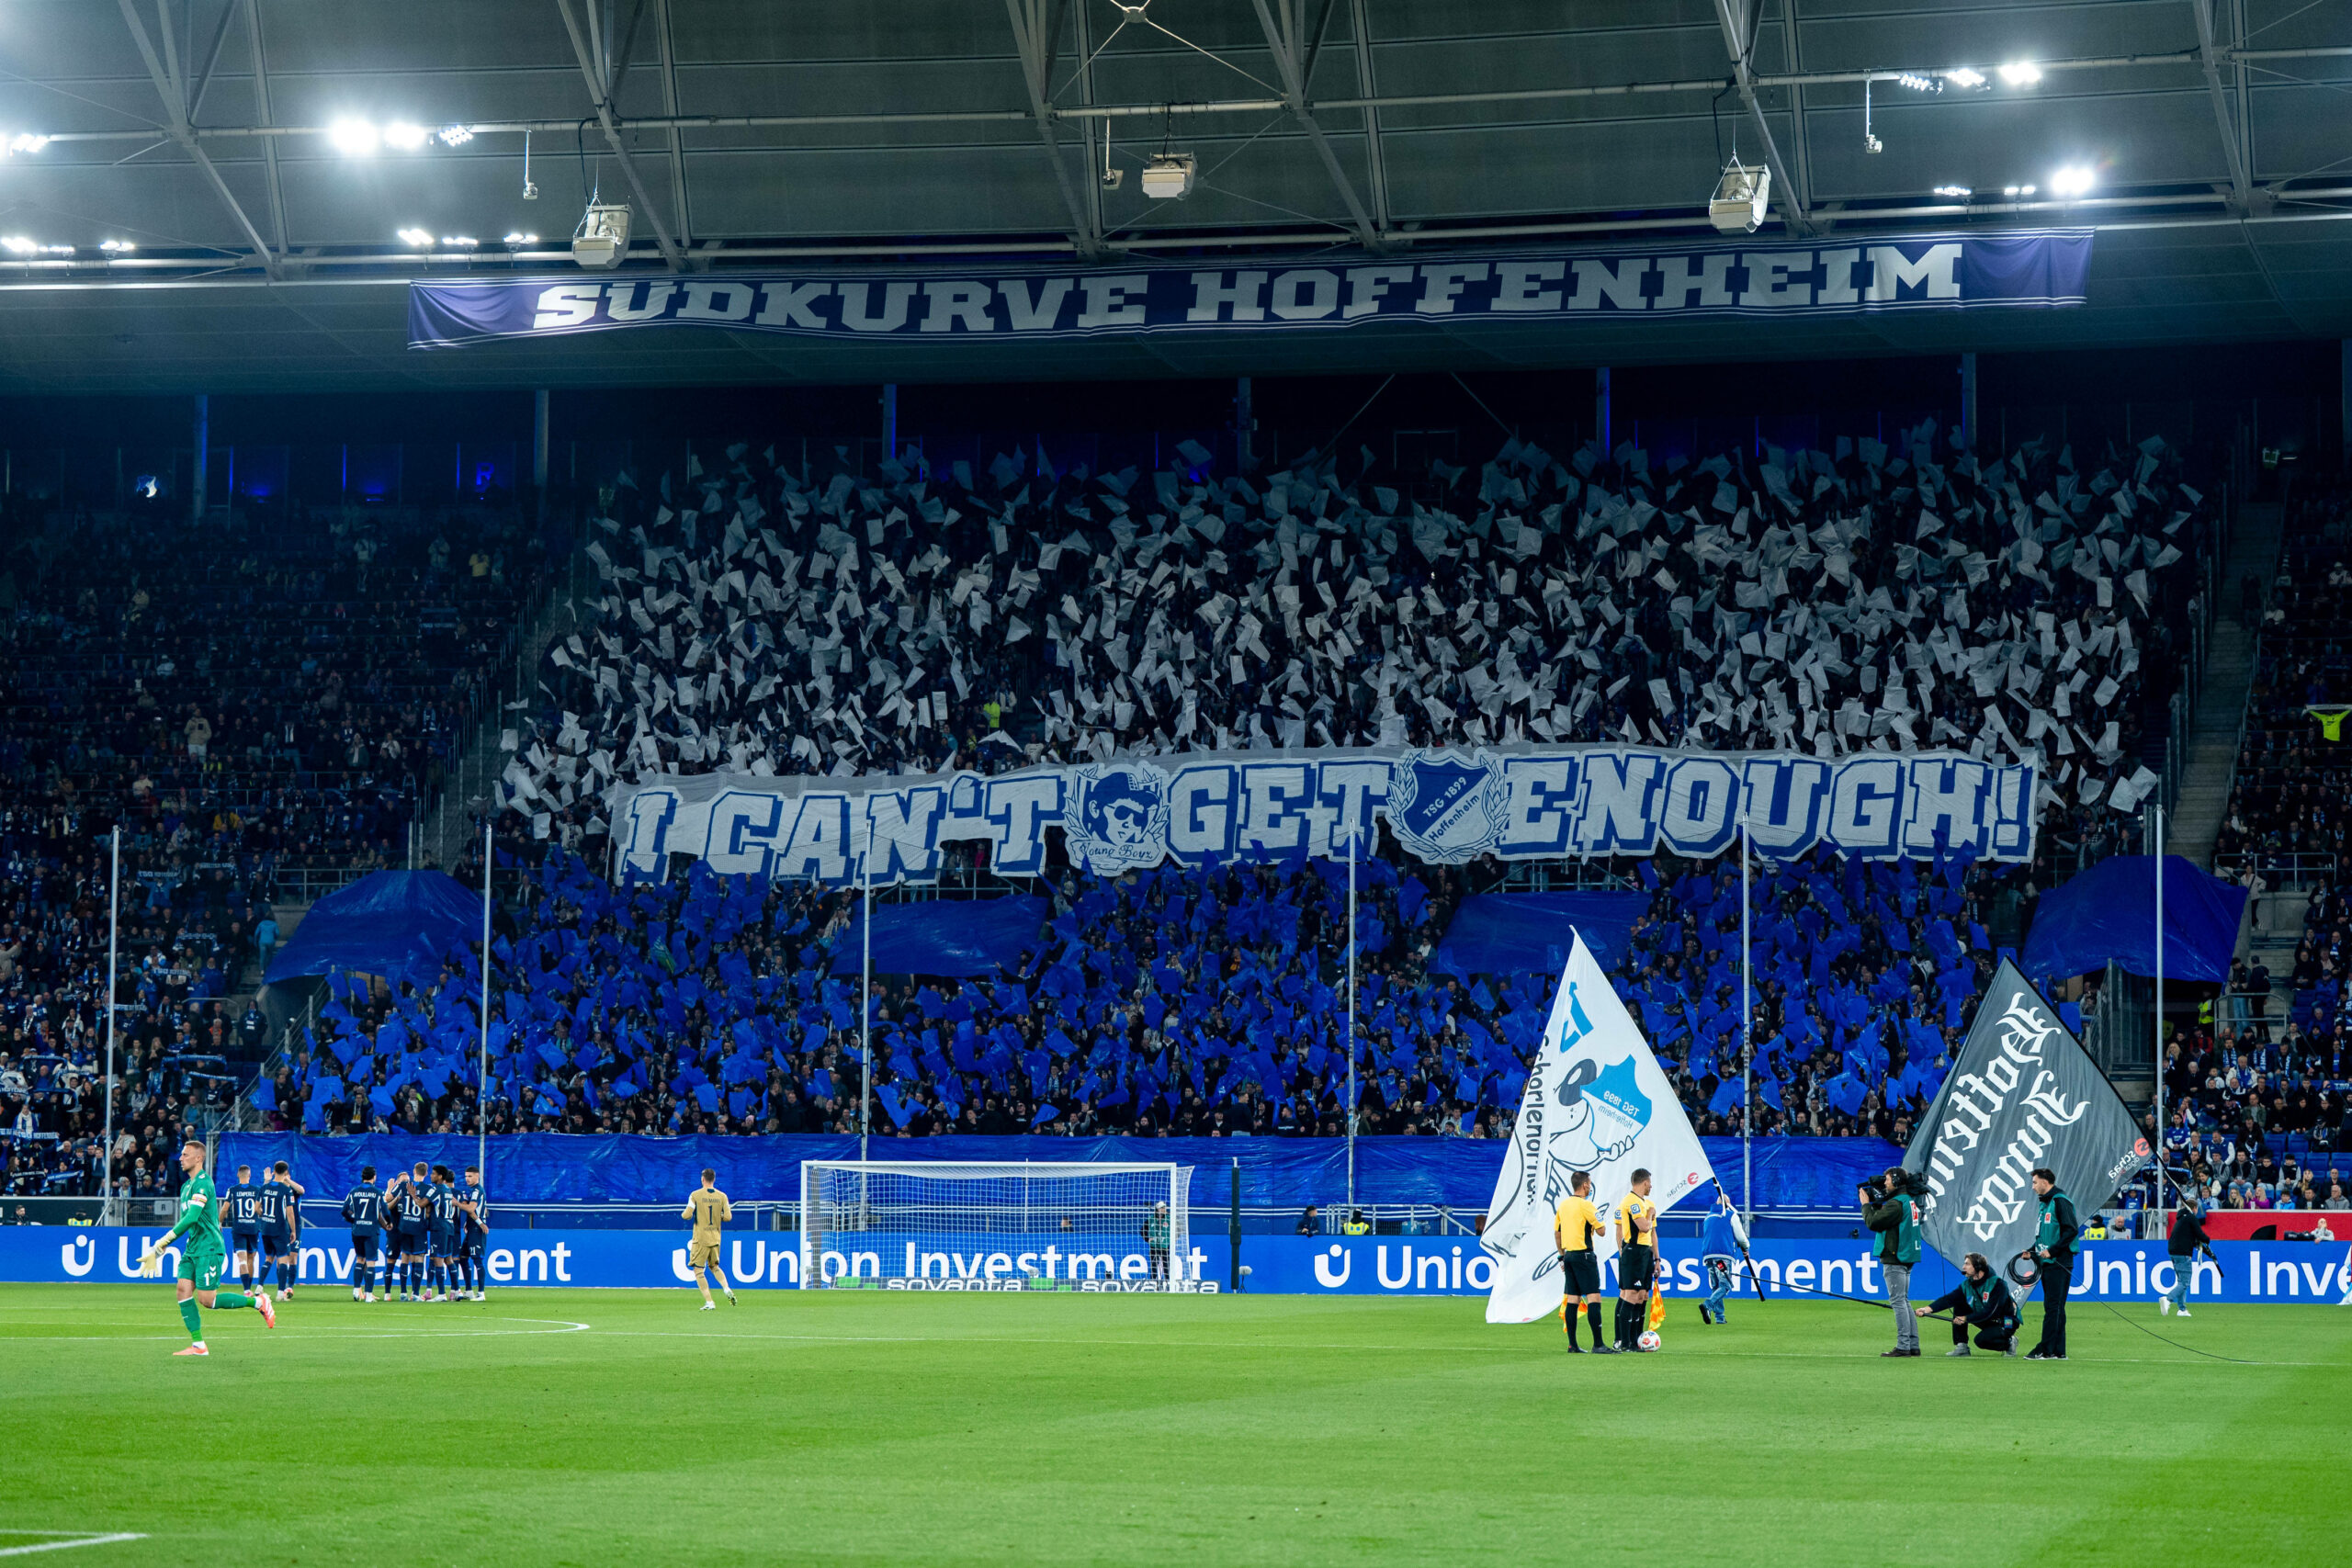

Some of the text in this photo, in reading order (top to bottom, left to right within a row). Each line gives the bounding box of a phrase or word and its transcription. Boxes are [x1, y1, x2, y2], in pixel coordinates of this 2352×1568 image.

[533, 243, 1964, 332] SÜDKURVE HOFFENHEIM
[1423, 776, 1467, 817] TSG 1899
[622, 791, 678, 882] I
[1165, 759, 1394, 863] GET
[1500, 753, 2031, 860] ENOUGH!
[1428, 795, 1480, 841] Hoffenheim
[1079, 842, 1153, 860] Young Boyz
[237, 1197, 255, 1218] 19
[263, 1196, 276, 1218] 11
[359, 1198, 369, 1219] 7
[707, 1204, 714, 1226] 1
[1377, 1245, 1498, 1290] Unio
[204, 1272, 210, 1286] 1
[887, 1278, 1023, 1292] sovanta
